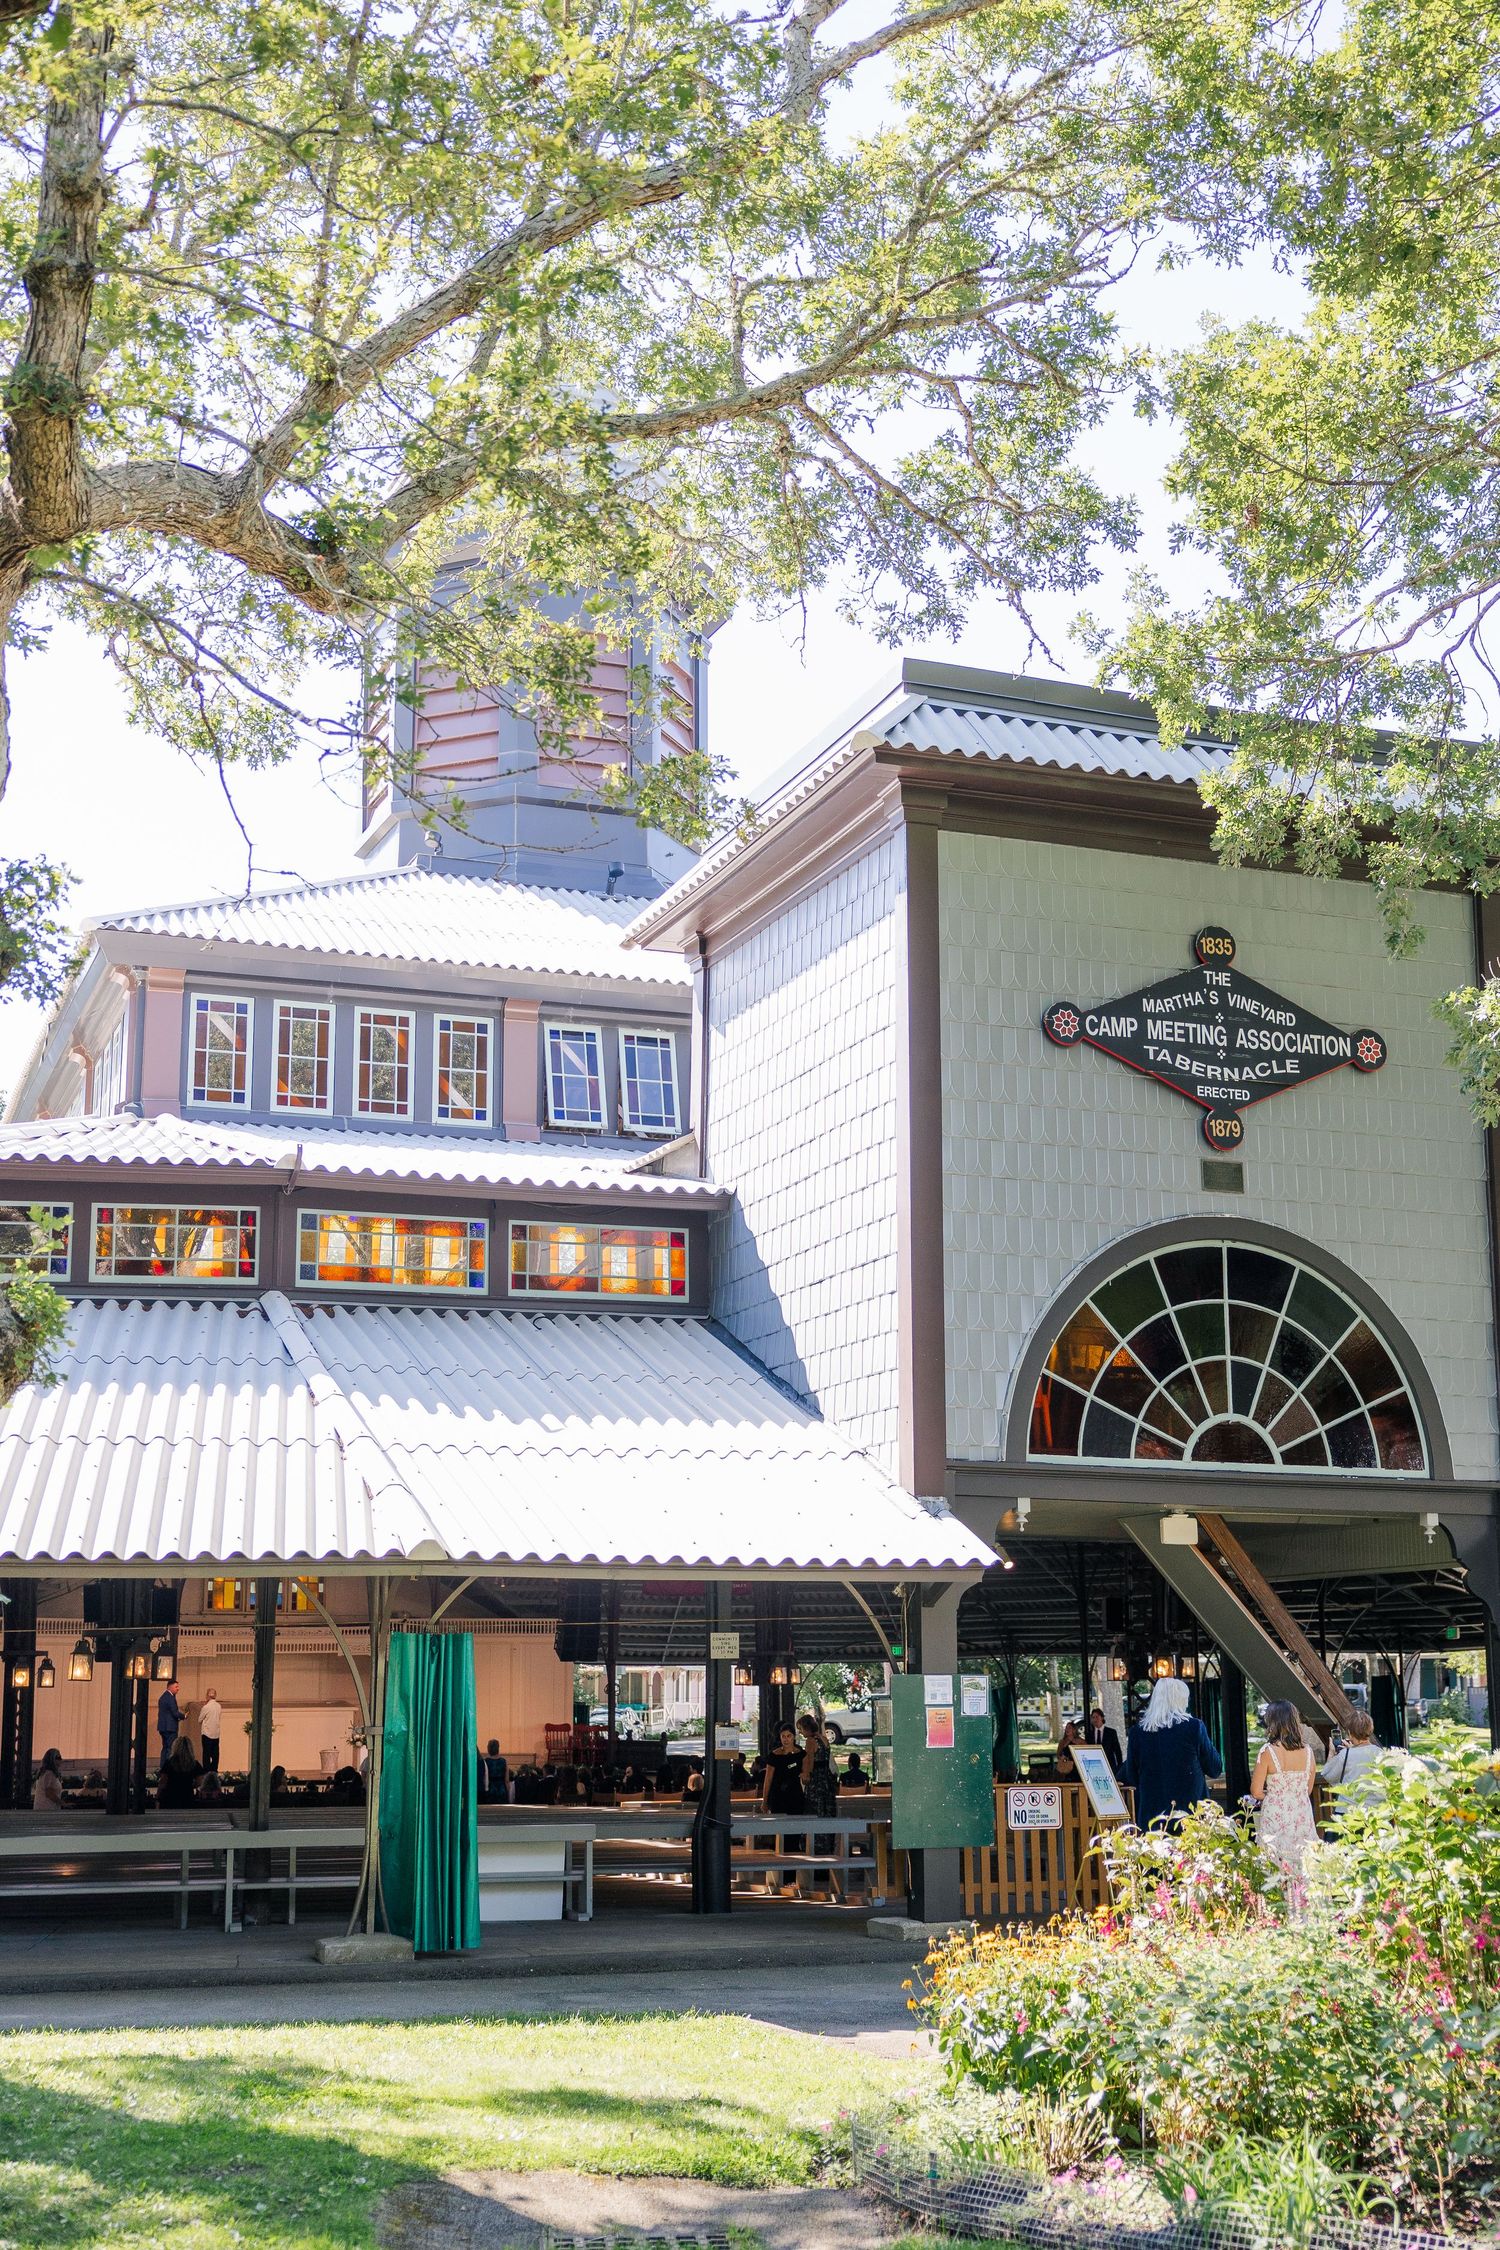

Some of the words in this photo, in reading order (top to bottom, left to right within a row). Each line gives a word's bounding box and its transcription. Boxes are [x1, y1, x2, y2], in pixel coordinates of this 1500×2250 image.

[1200, 937, 1233, 956] 1835
[1203, 970, 1231, 987] THE
[1142, 988, 1219, 1013] MARTHA'S
[1227, 992, 1296, 1027] VINEYARD
[1085, 1014, 1138, 1038] CAMP
[1147, 1018, 1228, 1047] MEETING
[1235, 1027, 1351, 1057] ASSOCIATION
[1143, 1045, 1300, 1081] TABERNACLE
[1197, 1085, 1250, 1101] ERECTED
[1209, 1119, 1241, 1138] 1879
[891, 1646, 902, 1655] EXIT
[1014, 1810, 1027, 1824] NO
